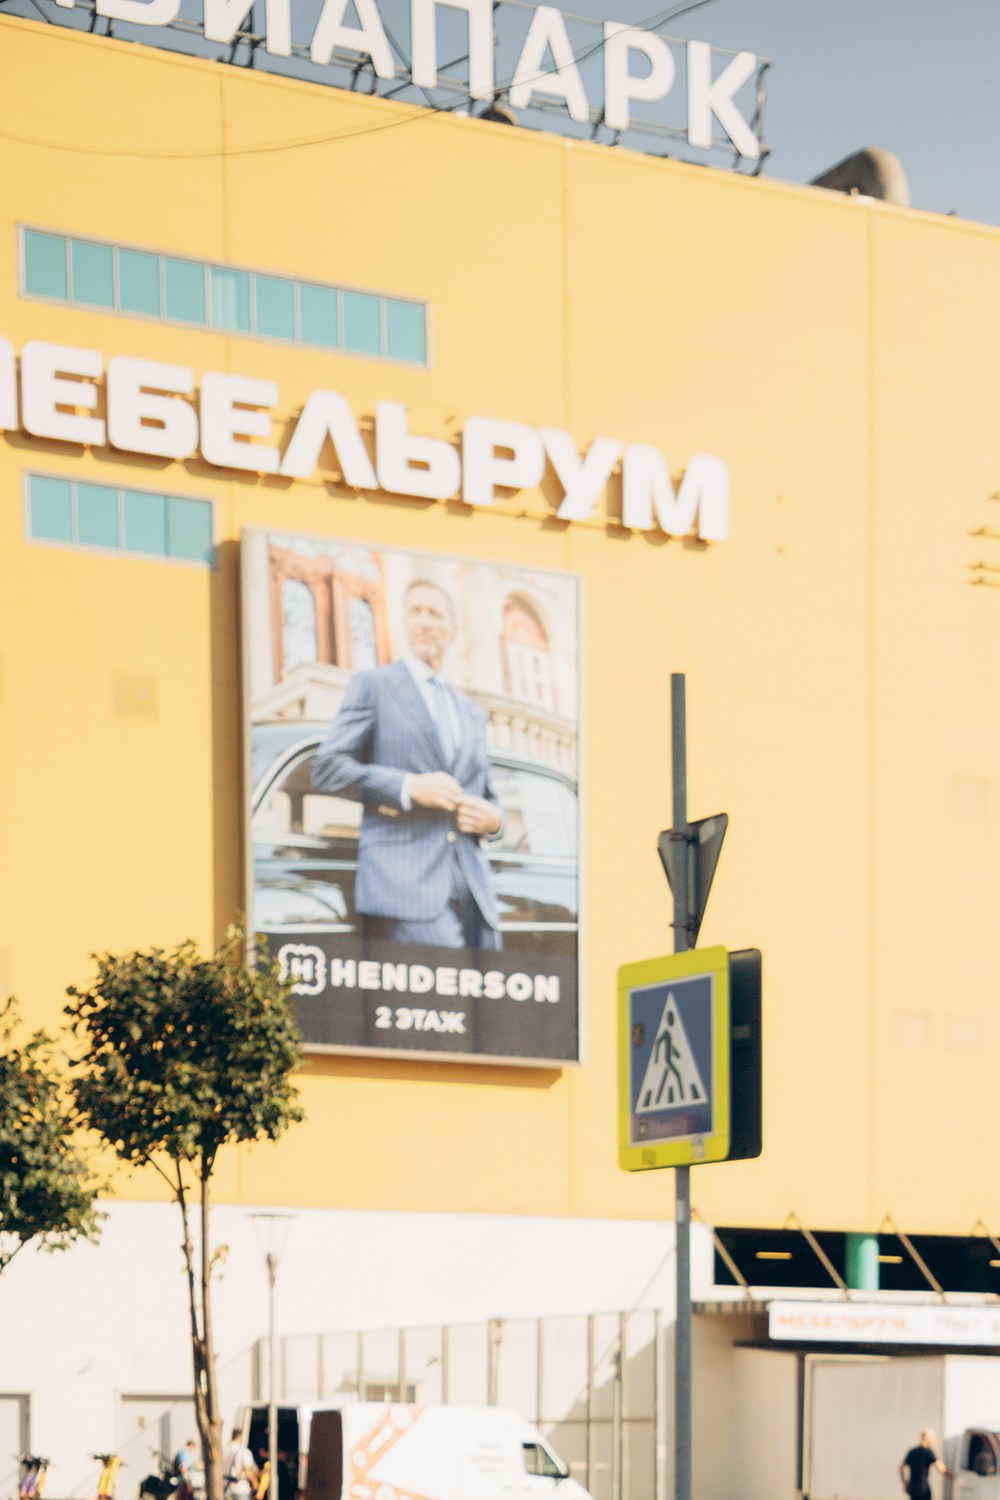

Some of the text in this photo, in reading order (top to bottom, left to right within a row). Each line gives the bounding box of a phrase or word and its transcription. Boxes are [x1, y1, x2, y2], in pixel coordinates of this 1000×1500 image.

[53, 0, 761, 158] АПАРК
[0, 336, 728, 541] ЕБЕЛЬРУМ
[331, 958, 560, 1003] HENDERSON
[375, 1006, 466, 1034] 2 ЭТАЖ
